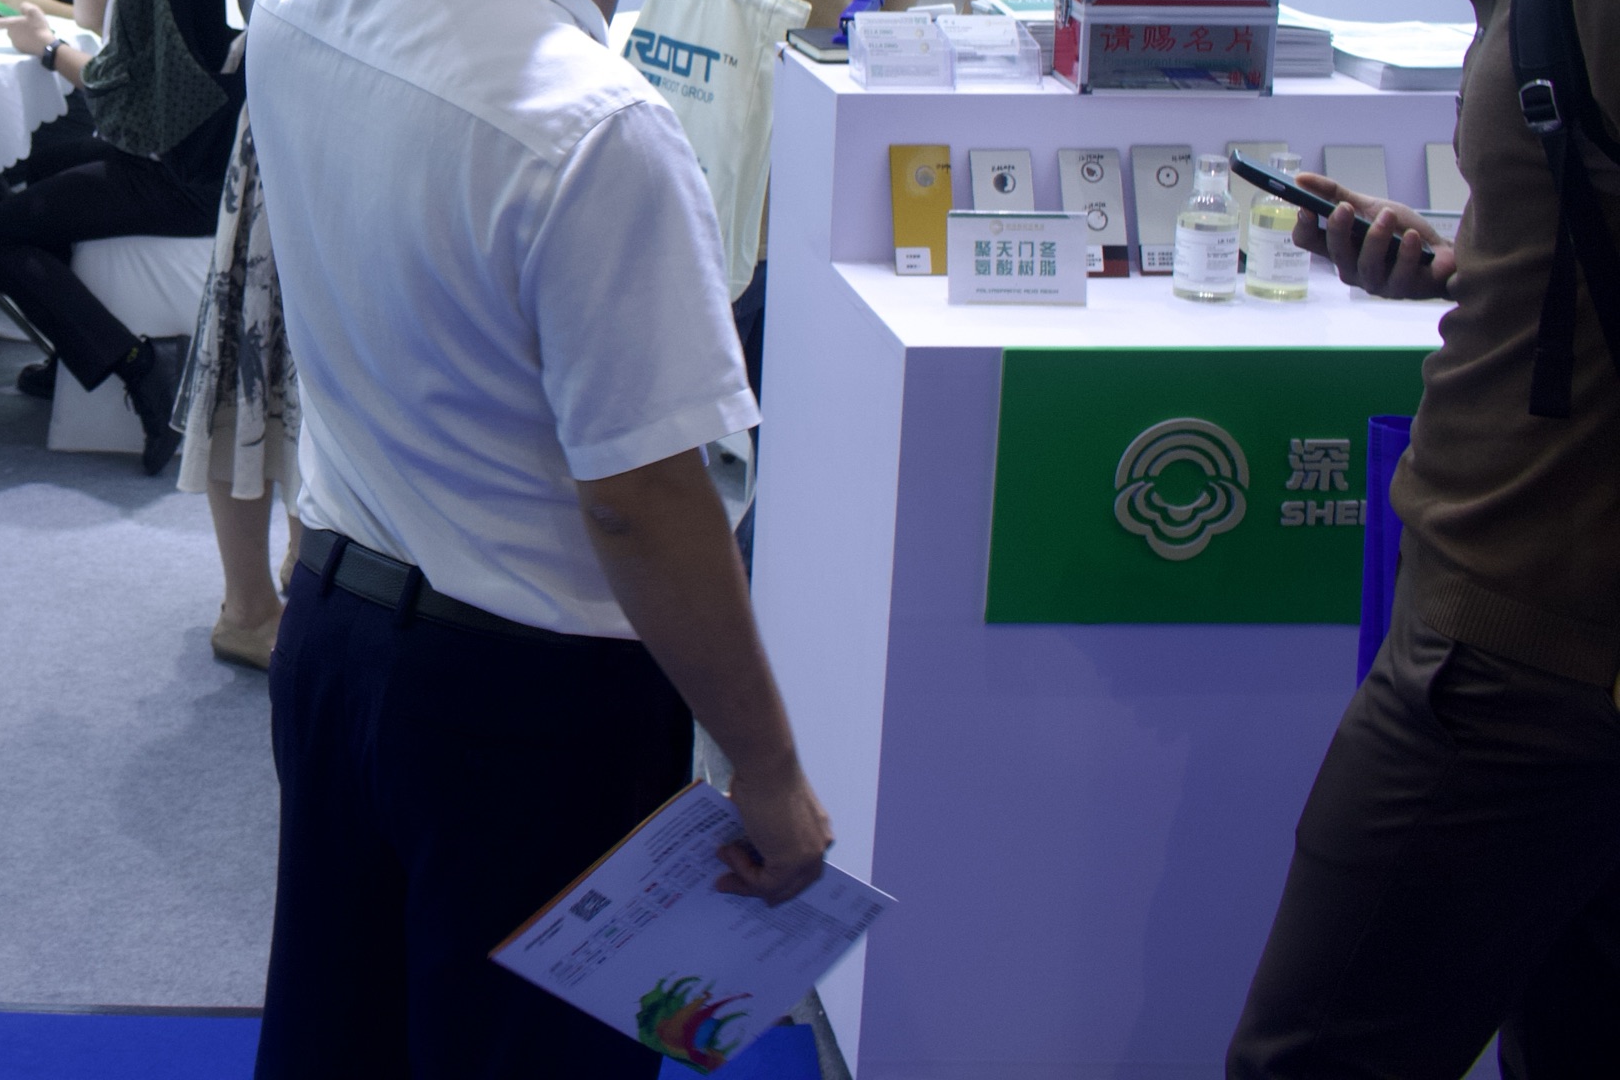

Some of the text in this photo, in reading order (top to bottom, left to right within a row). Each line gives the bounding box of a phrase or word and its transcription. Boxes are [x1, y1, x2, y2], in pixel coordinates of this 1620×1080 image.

[1100, 24, 1254, 53] 请赐名片
[1284, 438, 1351, 491] 深
